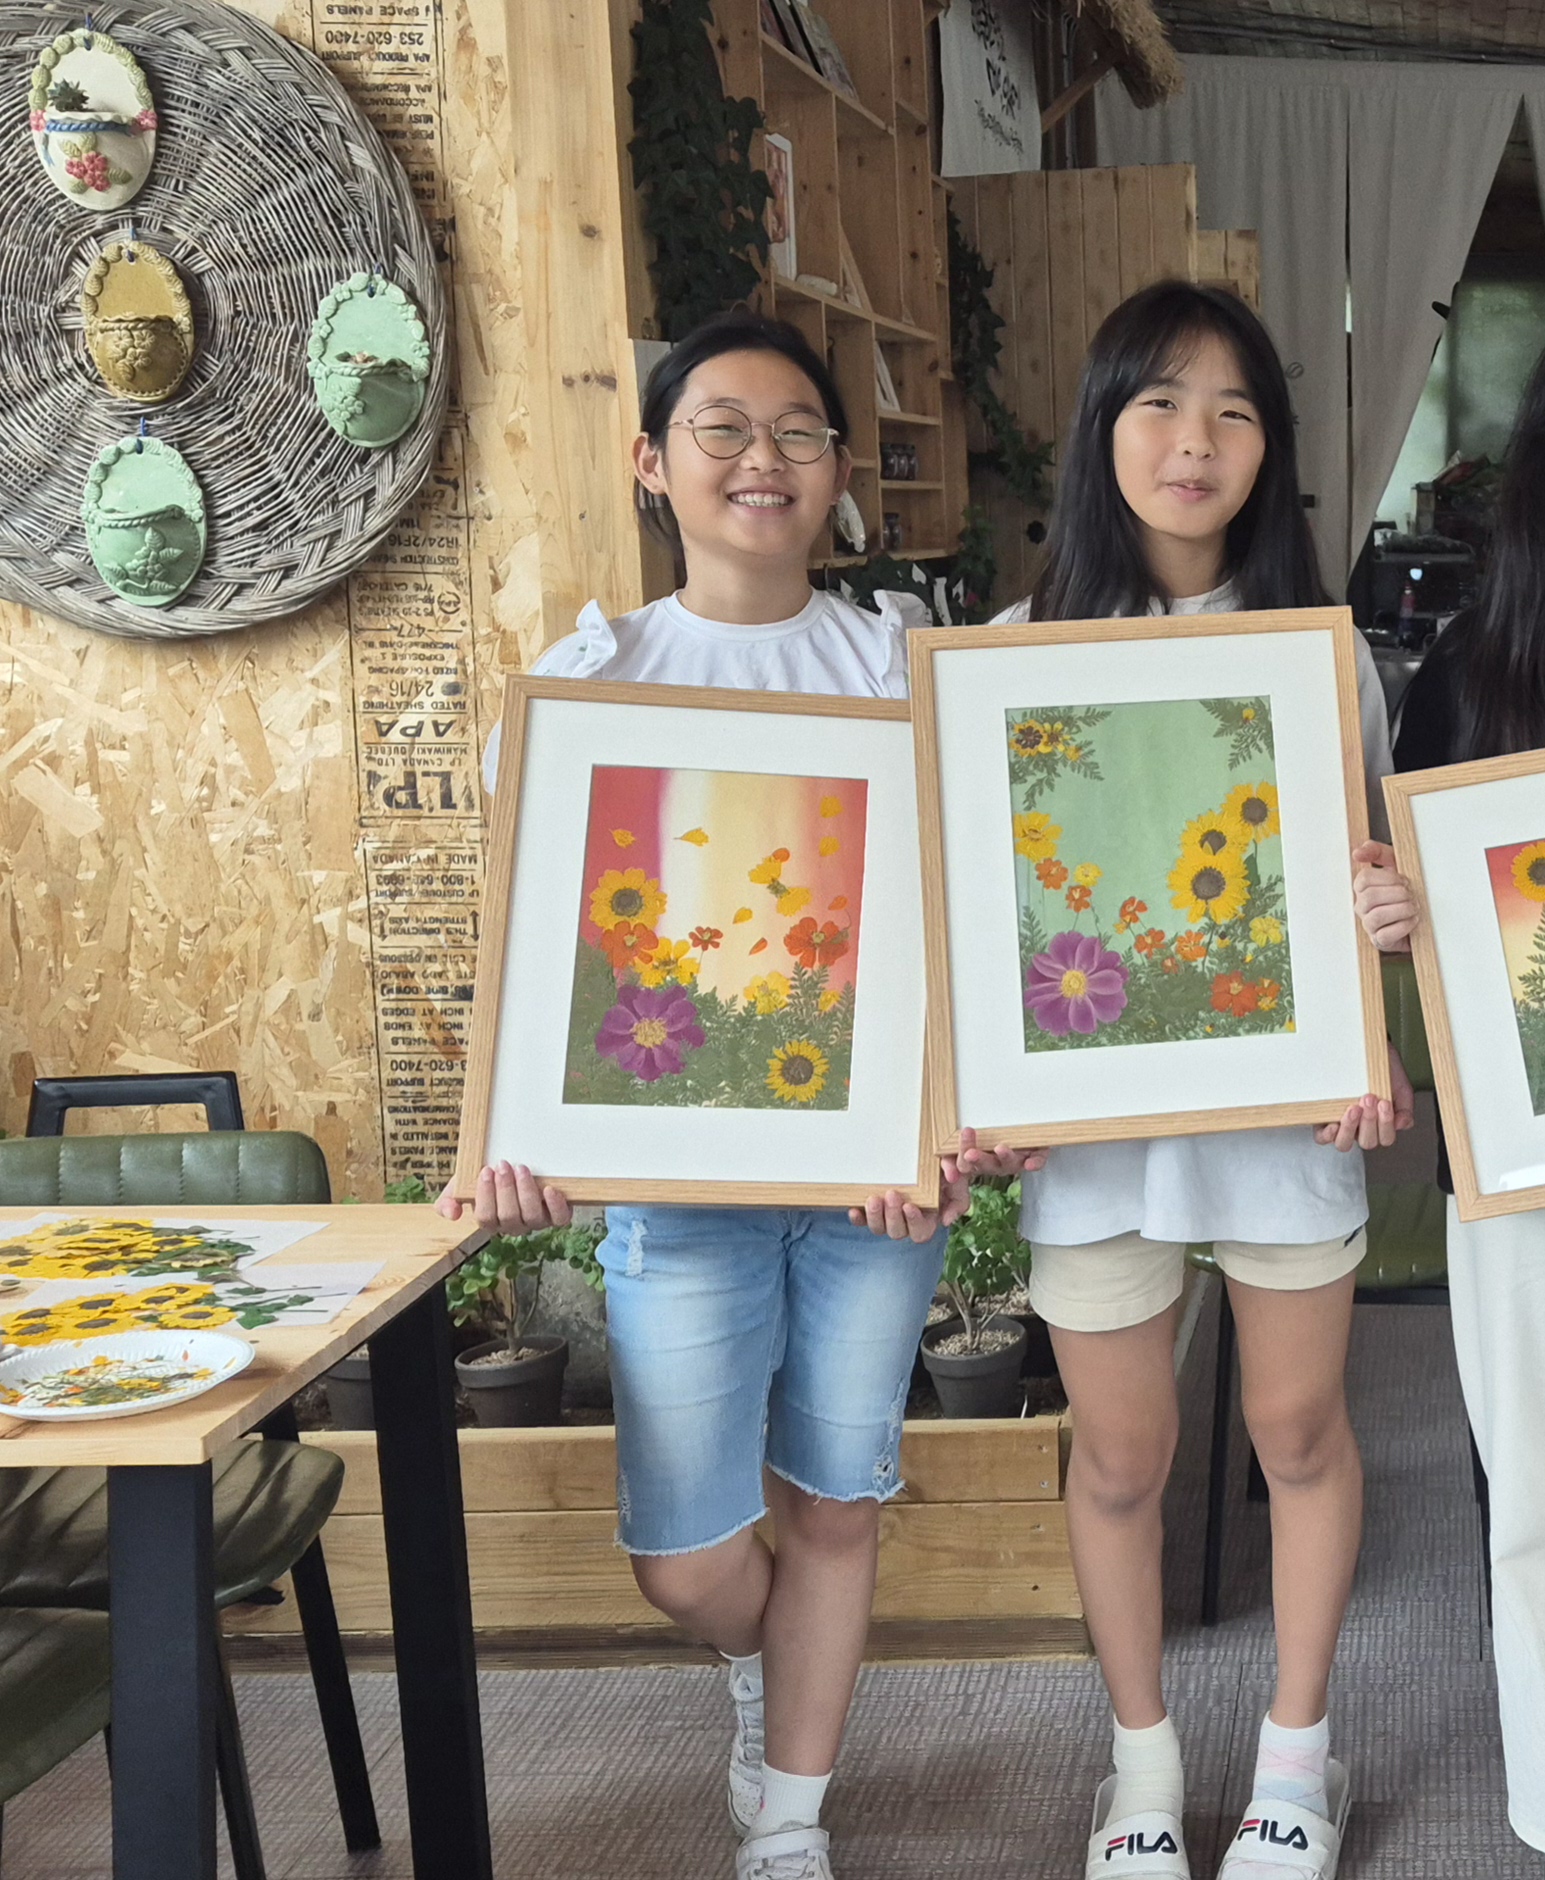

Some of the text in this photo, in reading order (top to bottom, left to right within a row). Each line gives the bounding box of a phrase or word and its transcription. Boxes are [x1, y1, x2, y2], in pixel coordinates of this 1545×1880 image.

[326, 5, 419, 16] SPACE PANELS
[389, 680, 434, 697] 24/16
[431, 701, 466, 710] RATED
[374, 720, 457, 738] APA
[382, 771, 458, 811] LP
[445, 854, 478, 864] MADE
[382, 1007, 464, 1016] INCH AT EDGES
[384, 1022, 412, 1030] ENDS
[438, 1022, 463, 1030] INCH
[1237, 1818, 1309, 1851] FILA
[1105, 1831, 1178, 1861] FILA
